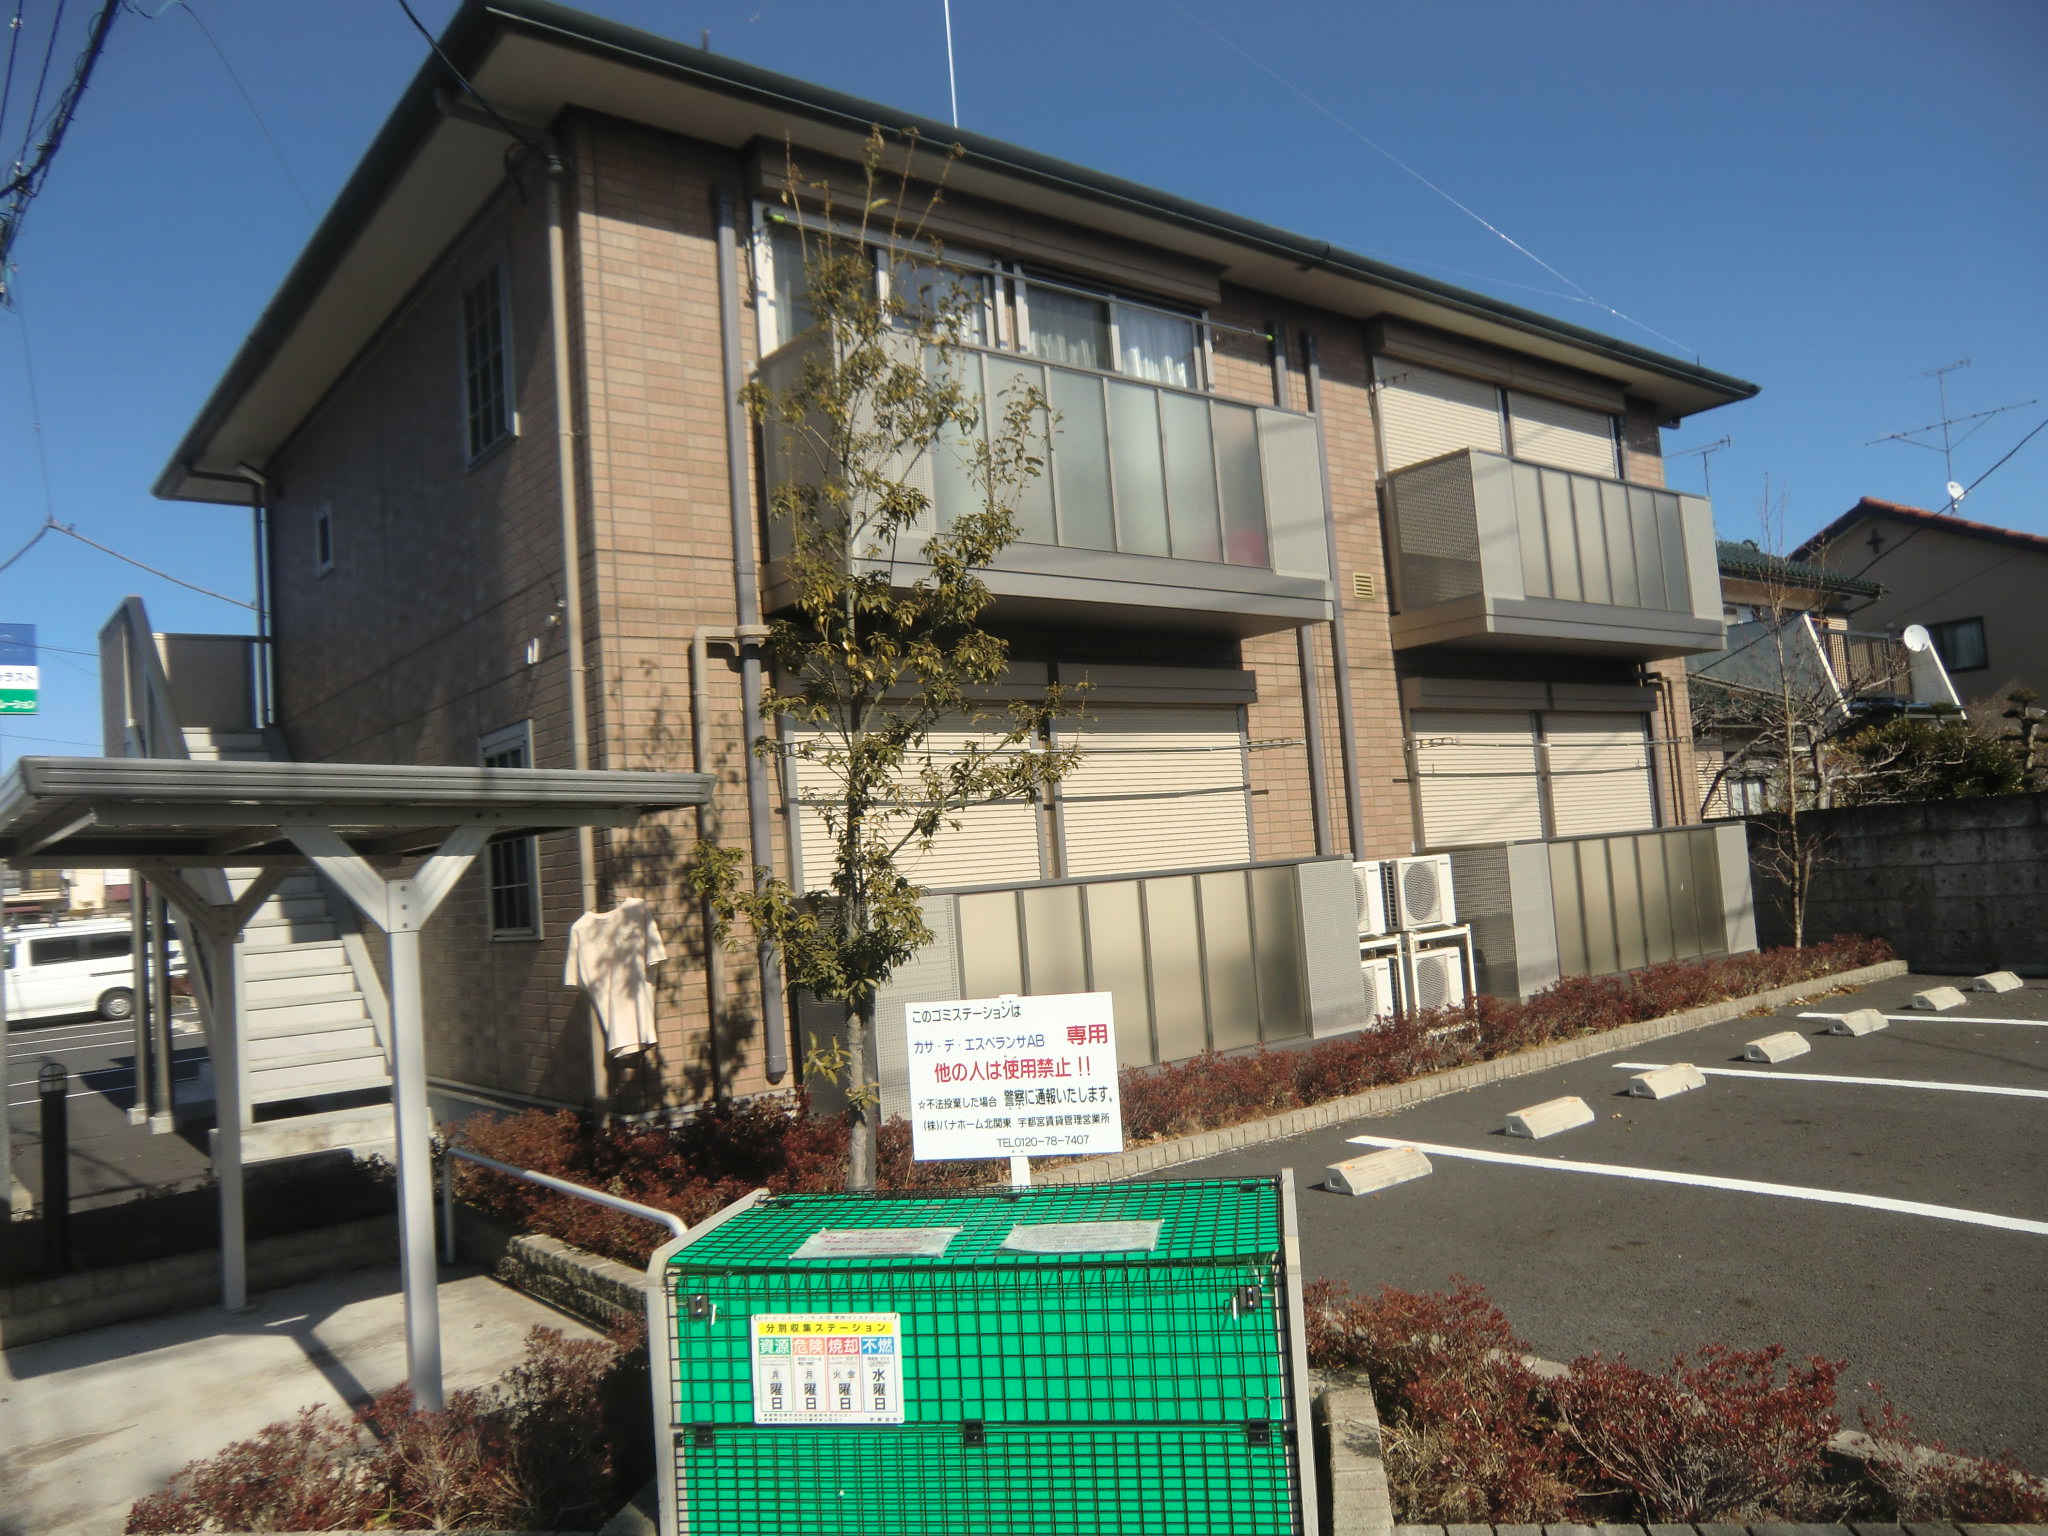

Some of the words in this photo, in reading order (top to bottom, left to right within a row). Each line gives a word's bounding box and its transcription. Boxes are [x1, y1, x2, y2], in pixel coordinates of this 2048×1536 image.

[912, 1004, 1022, 1024] このゴミステーションは
[1066, 1023, 1108, 1046] 専用
[1003, 1085, 1114, 1108] 警察に通報いたします。
[1017, 1112, 1111, 1129] 宇都宮賃貸管理営業所
[765, 1323, 887, 1333] 分別収集ステーション
[759, 1338, 790, 1354] 資源
[793, 1338, 825, 1354] 危険
[828, 1338, 859, 1354] 焼却
[862, 1337, 895, 1354] 不燃
